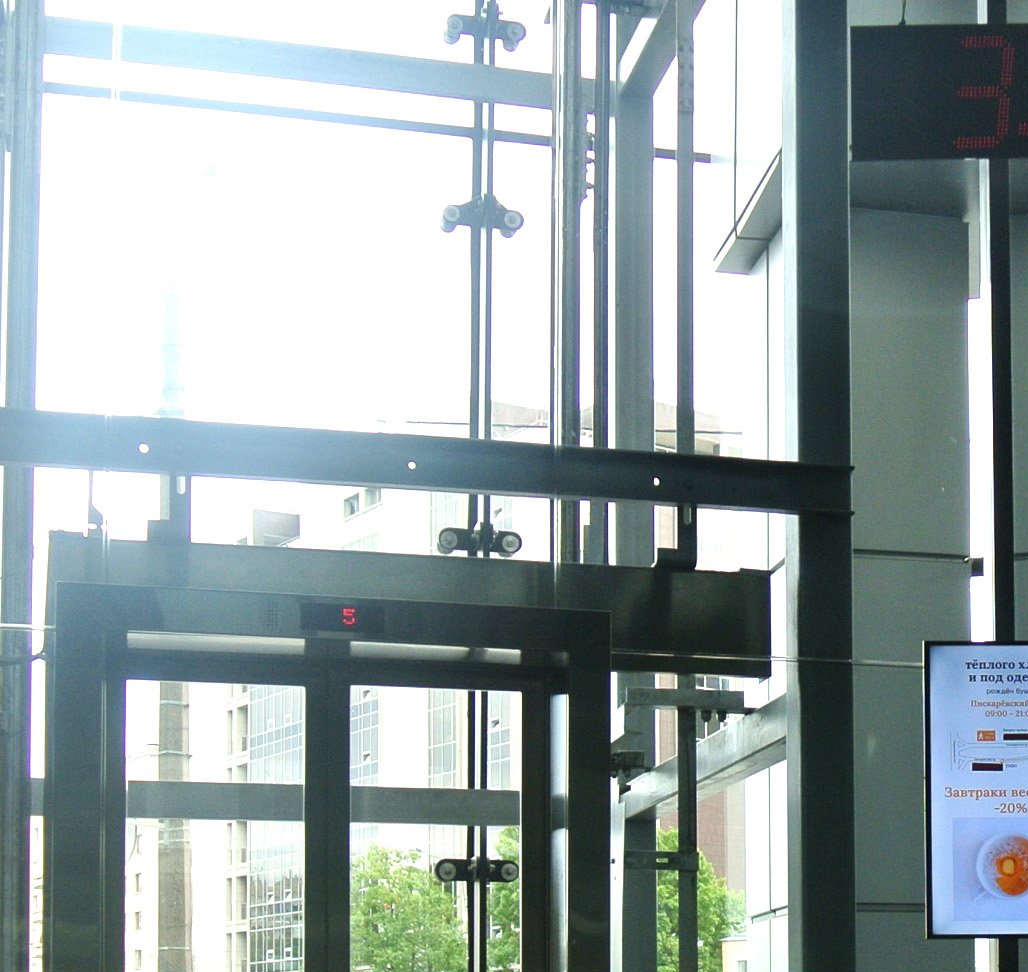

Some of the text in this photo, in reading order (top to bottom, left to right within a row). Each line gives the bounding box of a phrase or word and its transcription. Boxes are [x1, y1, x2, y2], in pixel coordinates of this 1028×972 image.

[342, 607, 356, 626] 5
[965, 659, 1015, 670] тёплого
[968, 674, 977, 682] и
[980, 674, 1004, 684] под
[944, 786, 1007, 800] Завтраки
[994, 802, 1028, 814] -20%
